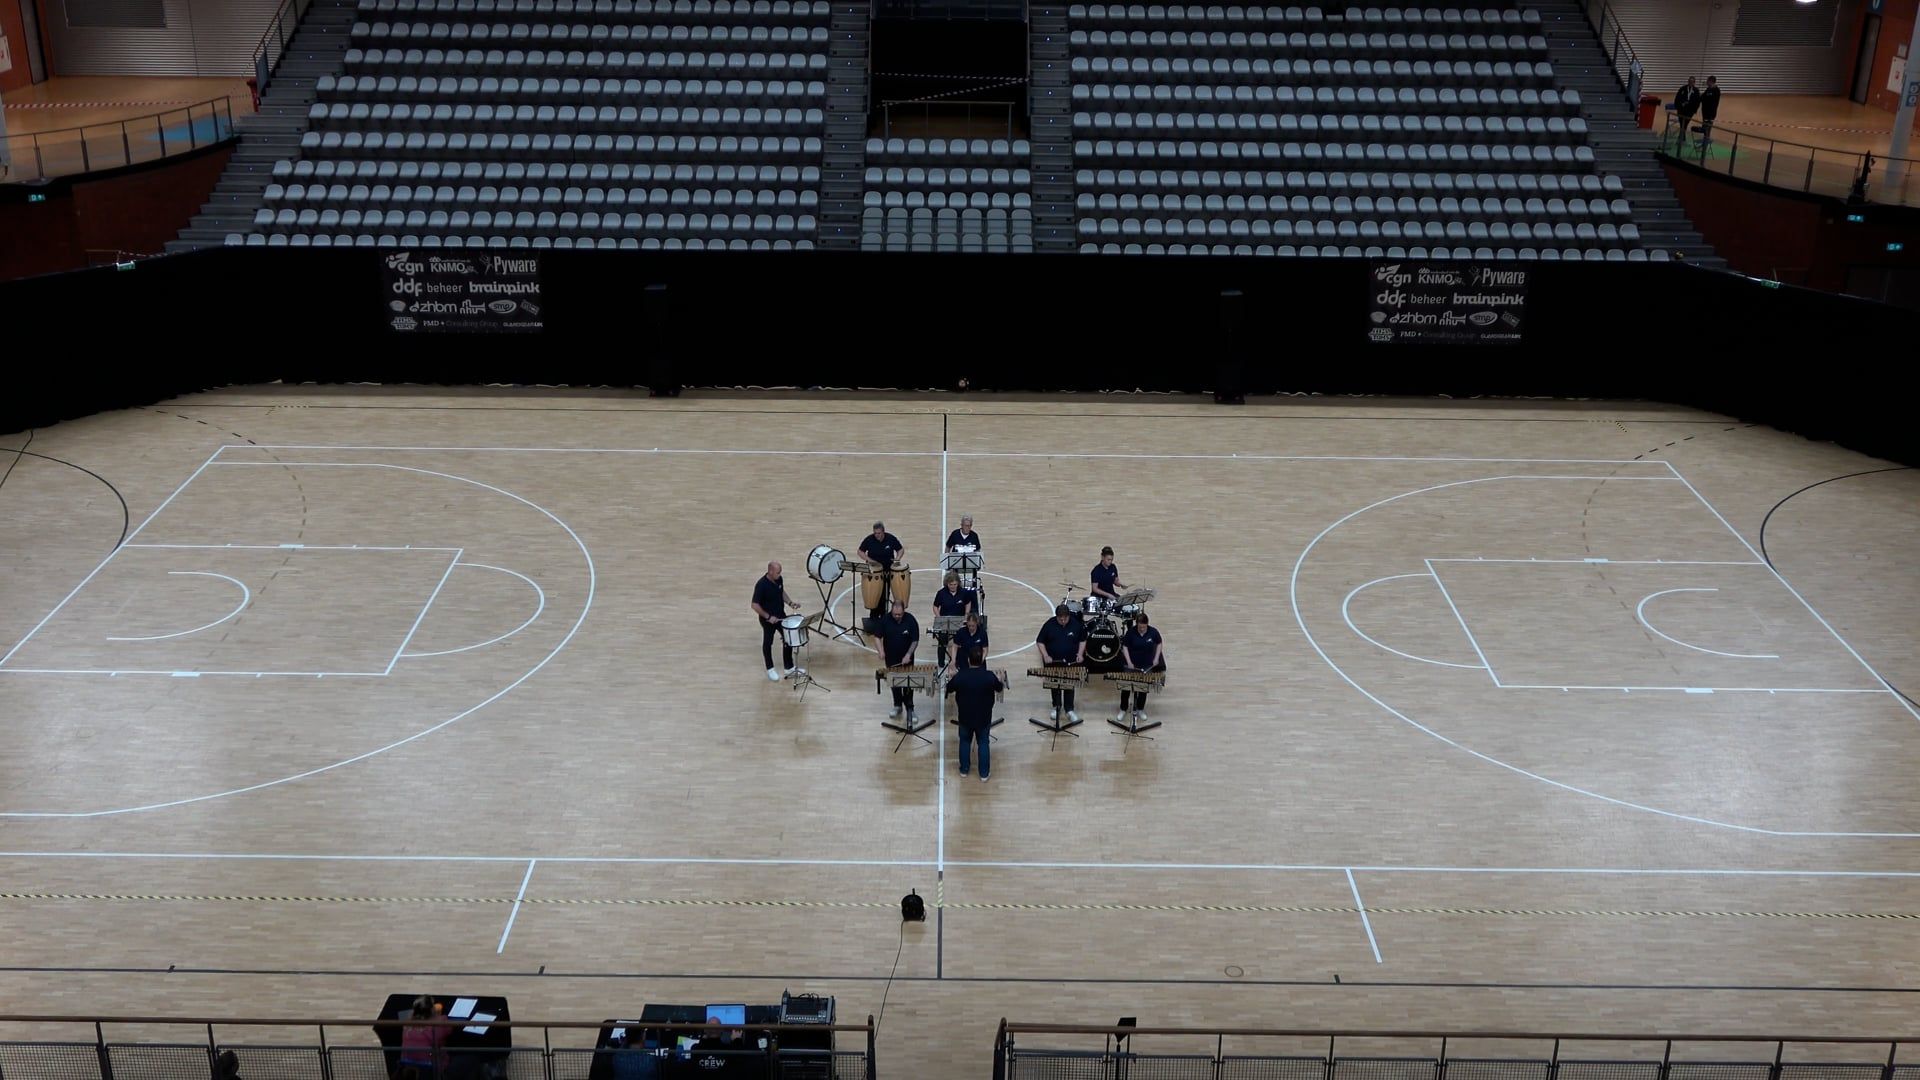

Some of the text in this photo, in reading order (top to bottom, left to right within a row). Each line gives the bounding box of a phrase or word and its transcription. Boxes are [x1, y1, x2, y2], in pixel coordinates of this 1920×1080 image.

[397, 262, 424, 276] cgn
[430, 262, 466, 273] KNMO
[493, 256, 537, 275] Pyware
[1386, 272, 1411, 288] cgn
[1418, 274, 1454, 285] KNMO
[1482, 267, 1525, 286] Pyware
[392, 277, 463, 296] ddf beheer
[469, 281, 540, 295] brainpink
[1376, 289, 1447, 308] ddf beheer
[1453, 292, 1525, 306] brainpink
[699, 1059, 726, 1067] CREW
